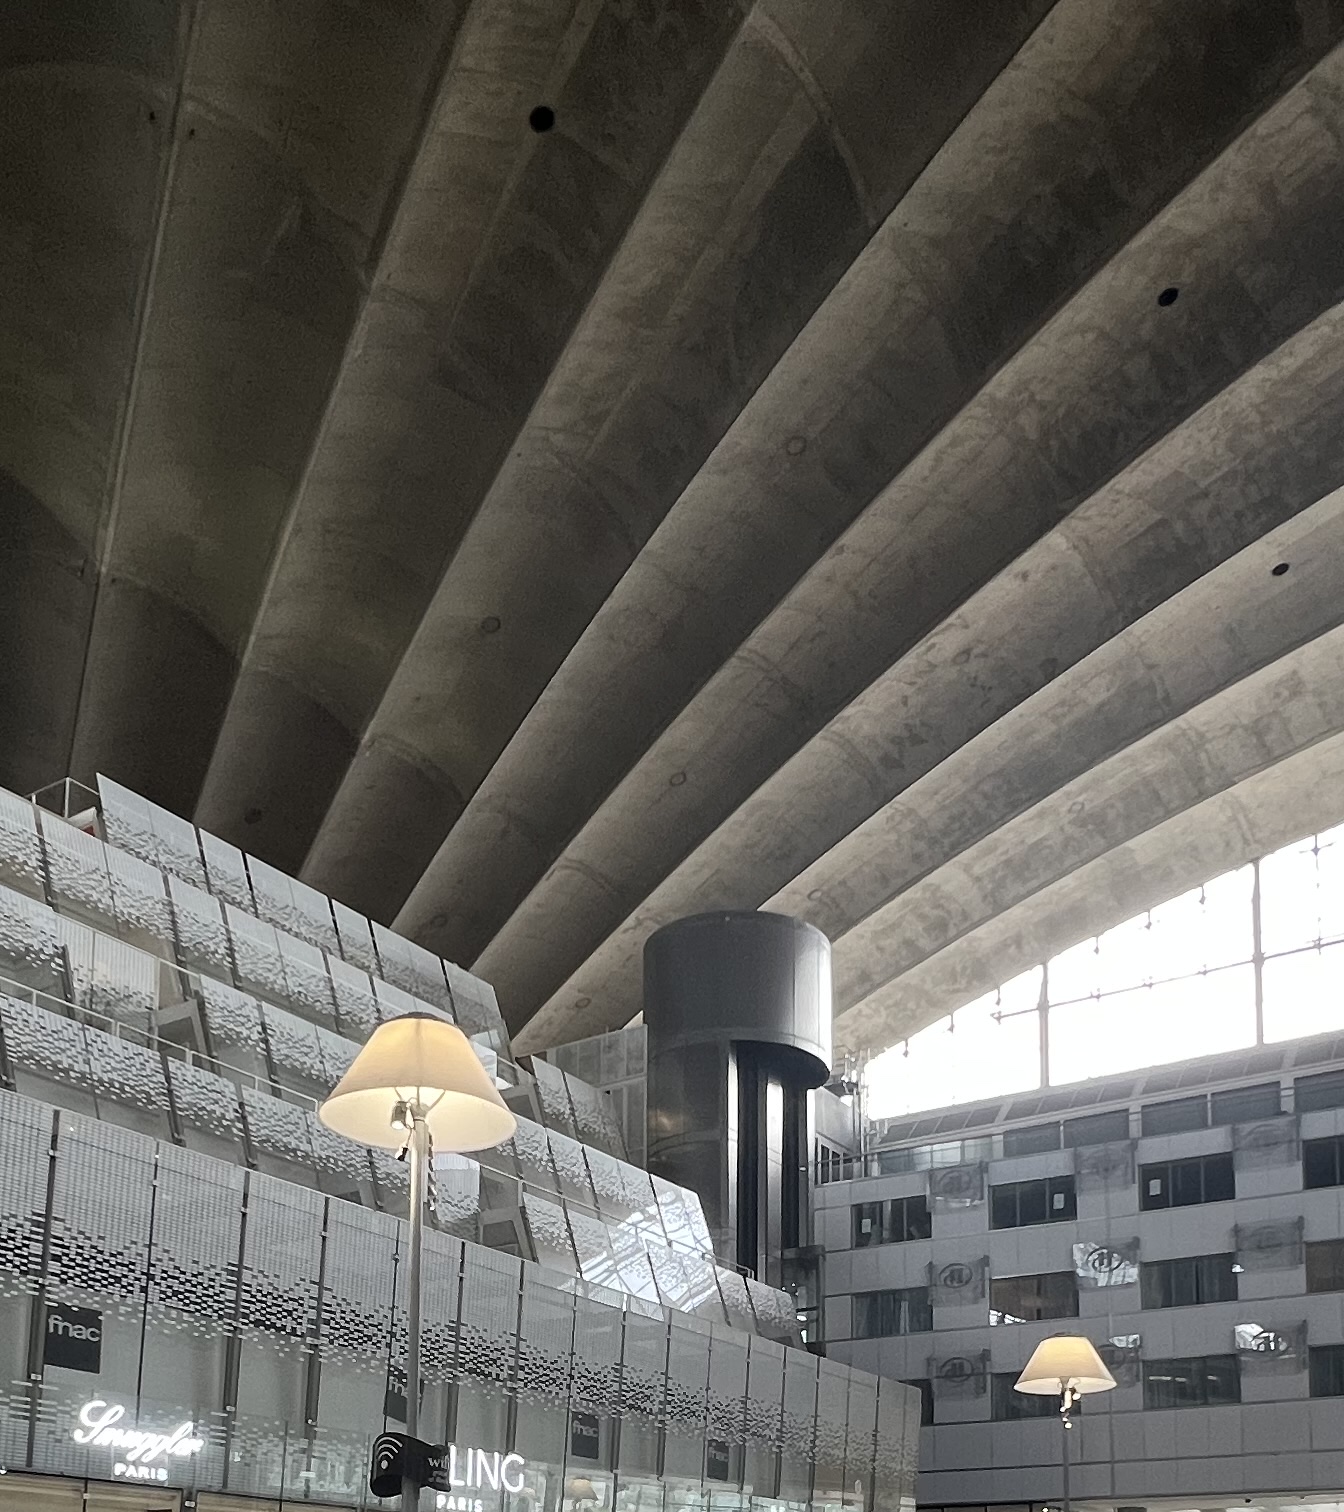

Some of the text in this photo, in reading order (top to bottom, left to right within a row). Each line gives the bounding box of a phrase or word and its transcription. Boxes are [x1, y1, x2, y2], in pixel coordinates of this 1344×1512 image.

[48, 1314, 101, 1342] fnac
[572, 1420, 599, 1438] fnac
[113, 1462, 169, 1481] PARIS
[449, 1444, 525, 1493] LING
[437, 1494, 483, 1512] PARIS
